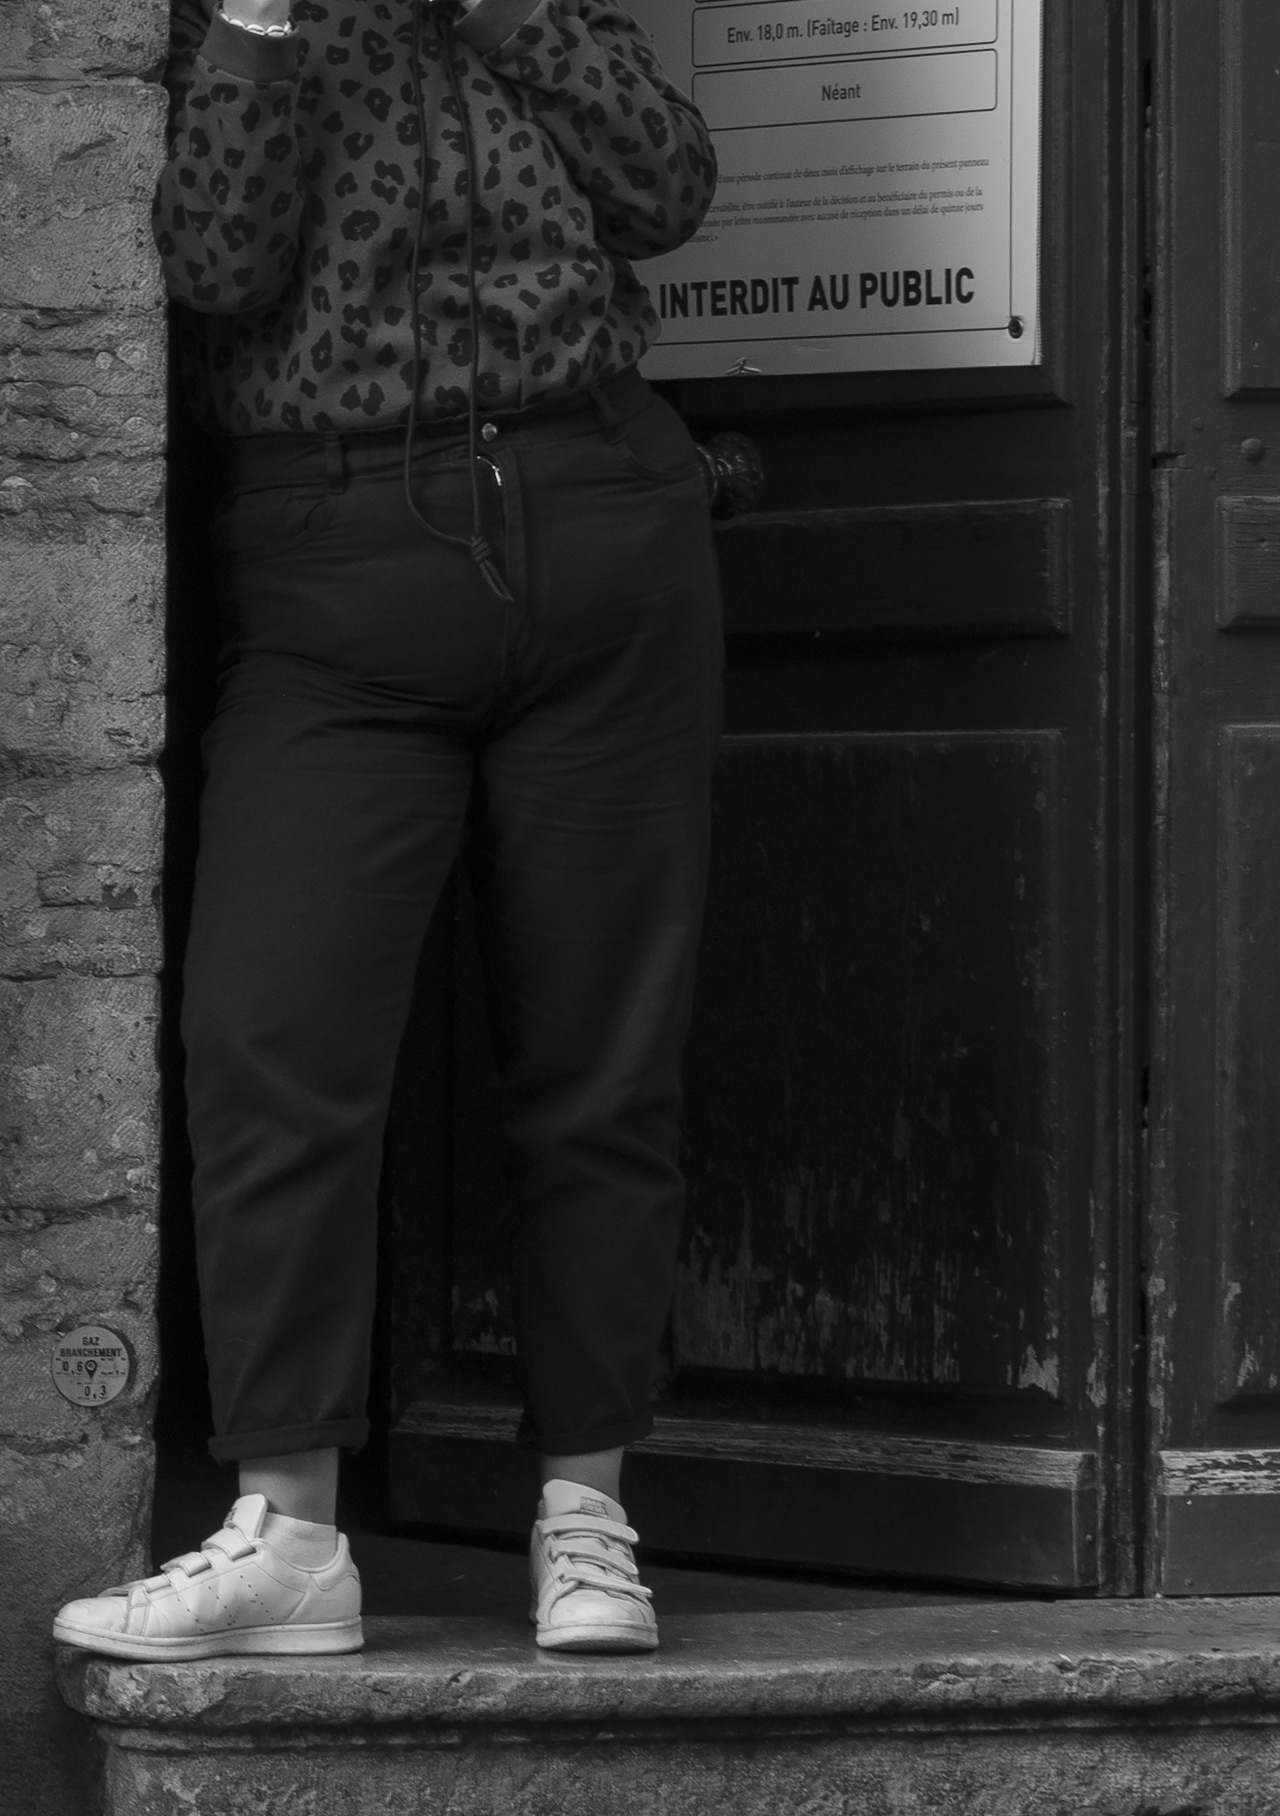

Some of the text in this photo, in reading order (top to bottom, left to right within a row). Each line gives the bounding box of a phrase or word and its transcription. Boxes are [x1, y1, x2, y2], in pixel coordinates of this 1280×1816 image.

[727, 6, 959, 43] Env. 18,0 m. (Faîtage Env. 19,30 m)
[820, 83, 861, 101] Néant
[660, 267, 975, 319] INTERDIT AU PUBLIC
[82, 1336, 100, 1346] GAZ
[59, 1347, 122, 1357] BRANCHEMENT
